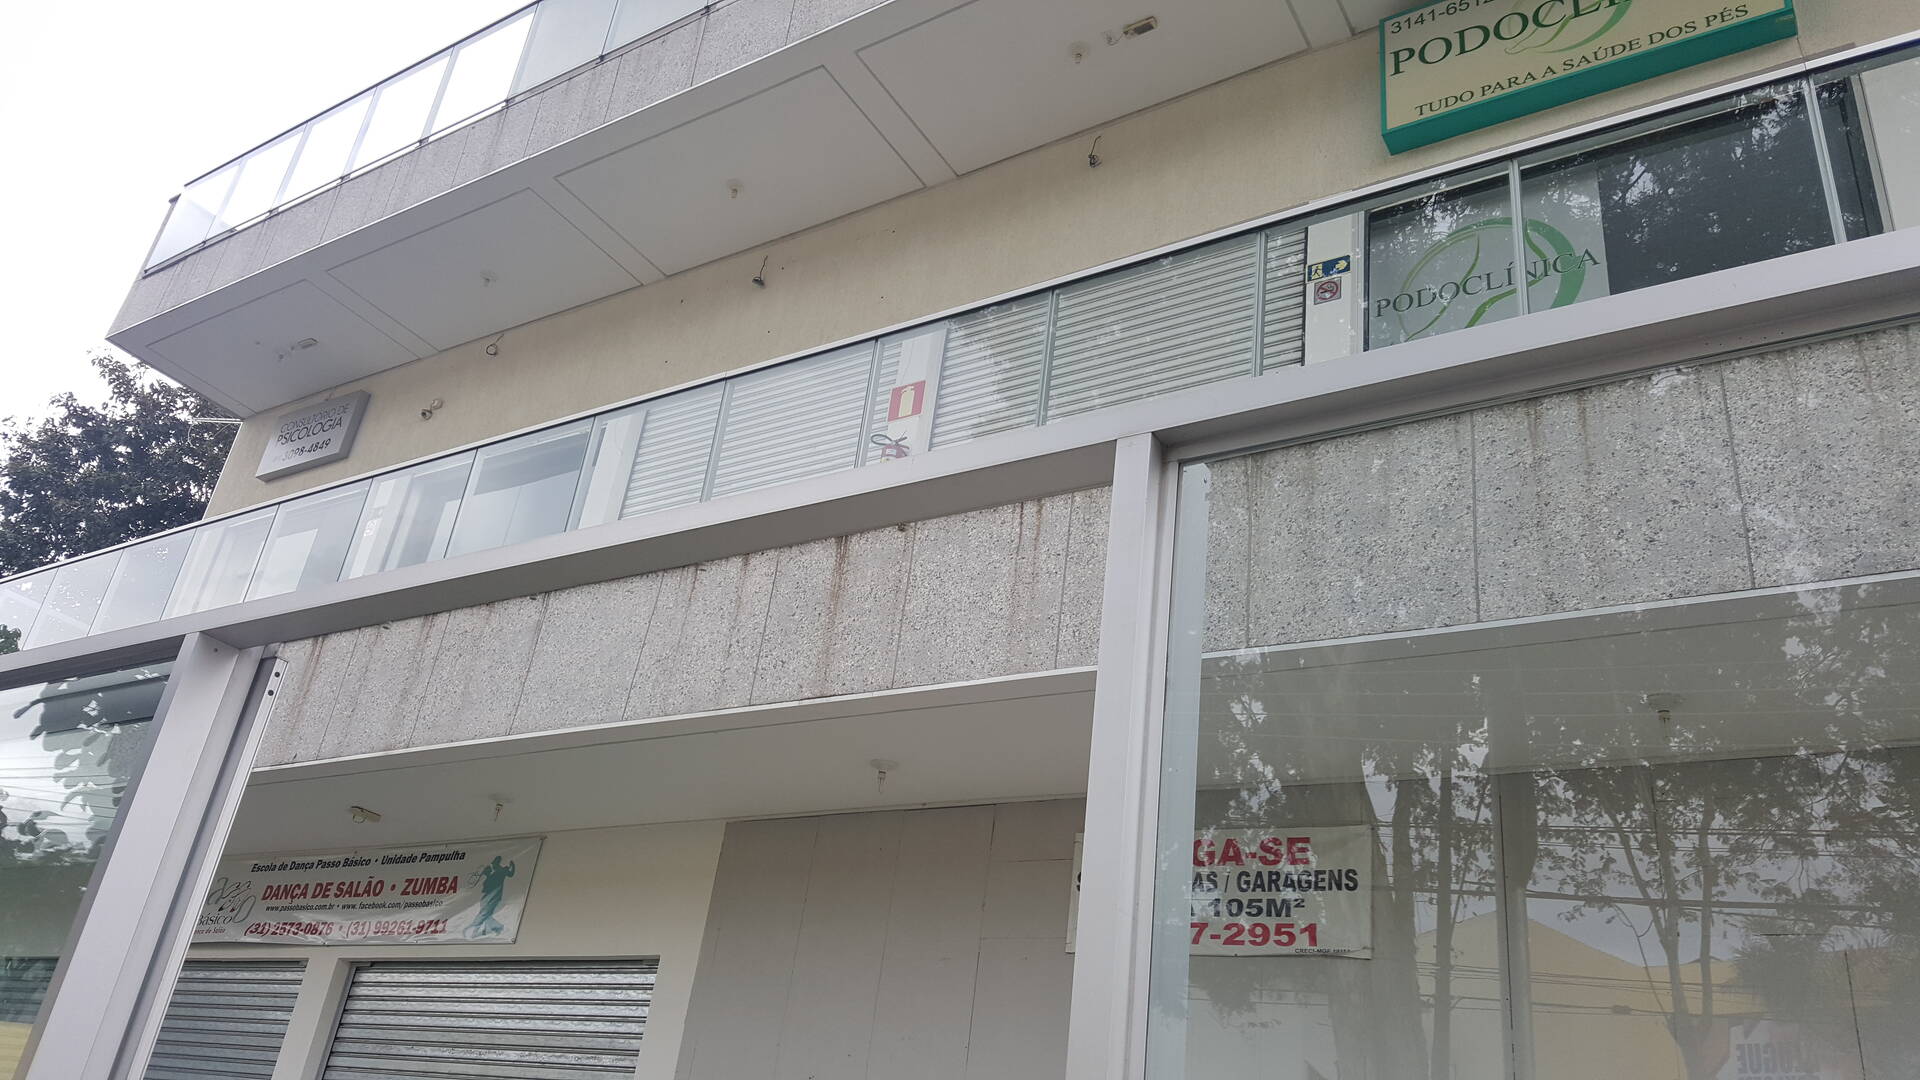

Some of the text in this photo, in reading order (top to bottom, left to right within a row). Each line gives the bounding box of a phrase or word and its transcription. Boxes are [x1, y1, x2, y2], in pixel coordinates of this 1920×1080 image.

[1416, 3, 1750, 116] TUDO PARA A SAÚDE DOS PÉS
[1375, 248, 1601, 318] PODOCLÍNICA
[337, 402, 351, 416] DE
[277, 416, 343, 445] PSICOLOGIA
[251, 850, 466, 873] Escola de Dança Passo Básico Unidade Pampulha
[1193, 836, 1311, 868] GA-SE
[261, 875, 459, 905] DANÇA DE SALÃO ZUMBA
[1236, 868, 1360, 894] GARAGENS
[244, 918, 449, 939] (31) 2573-0876 (31) 99261-9711
[1190, 922, 1318, 948] 7-2951
